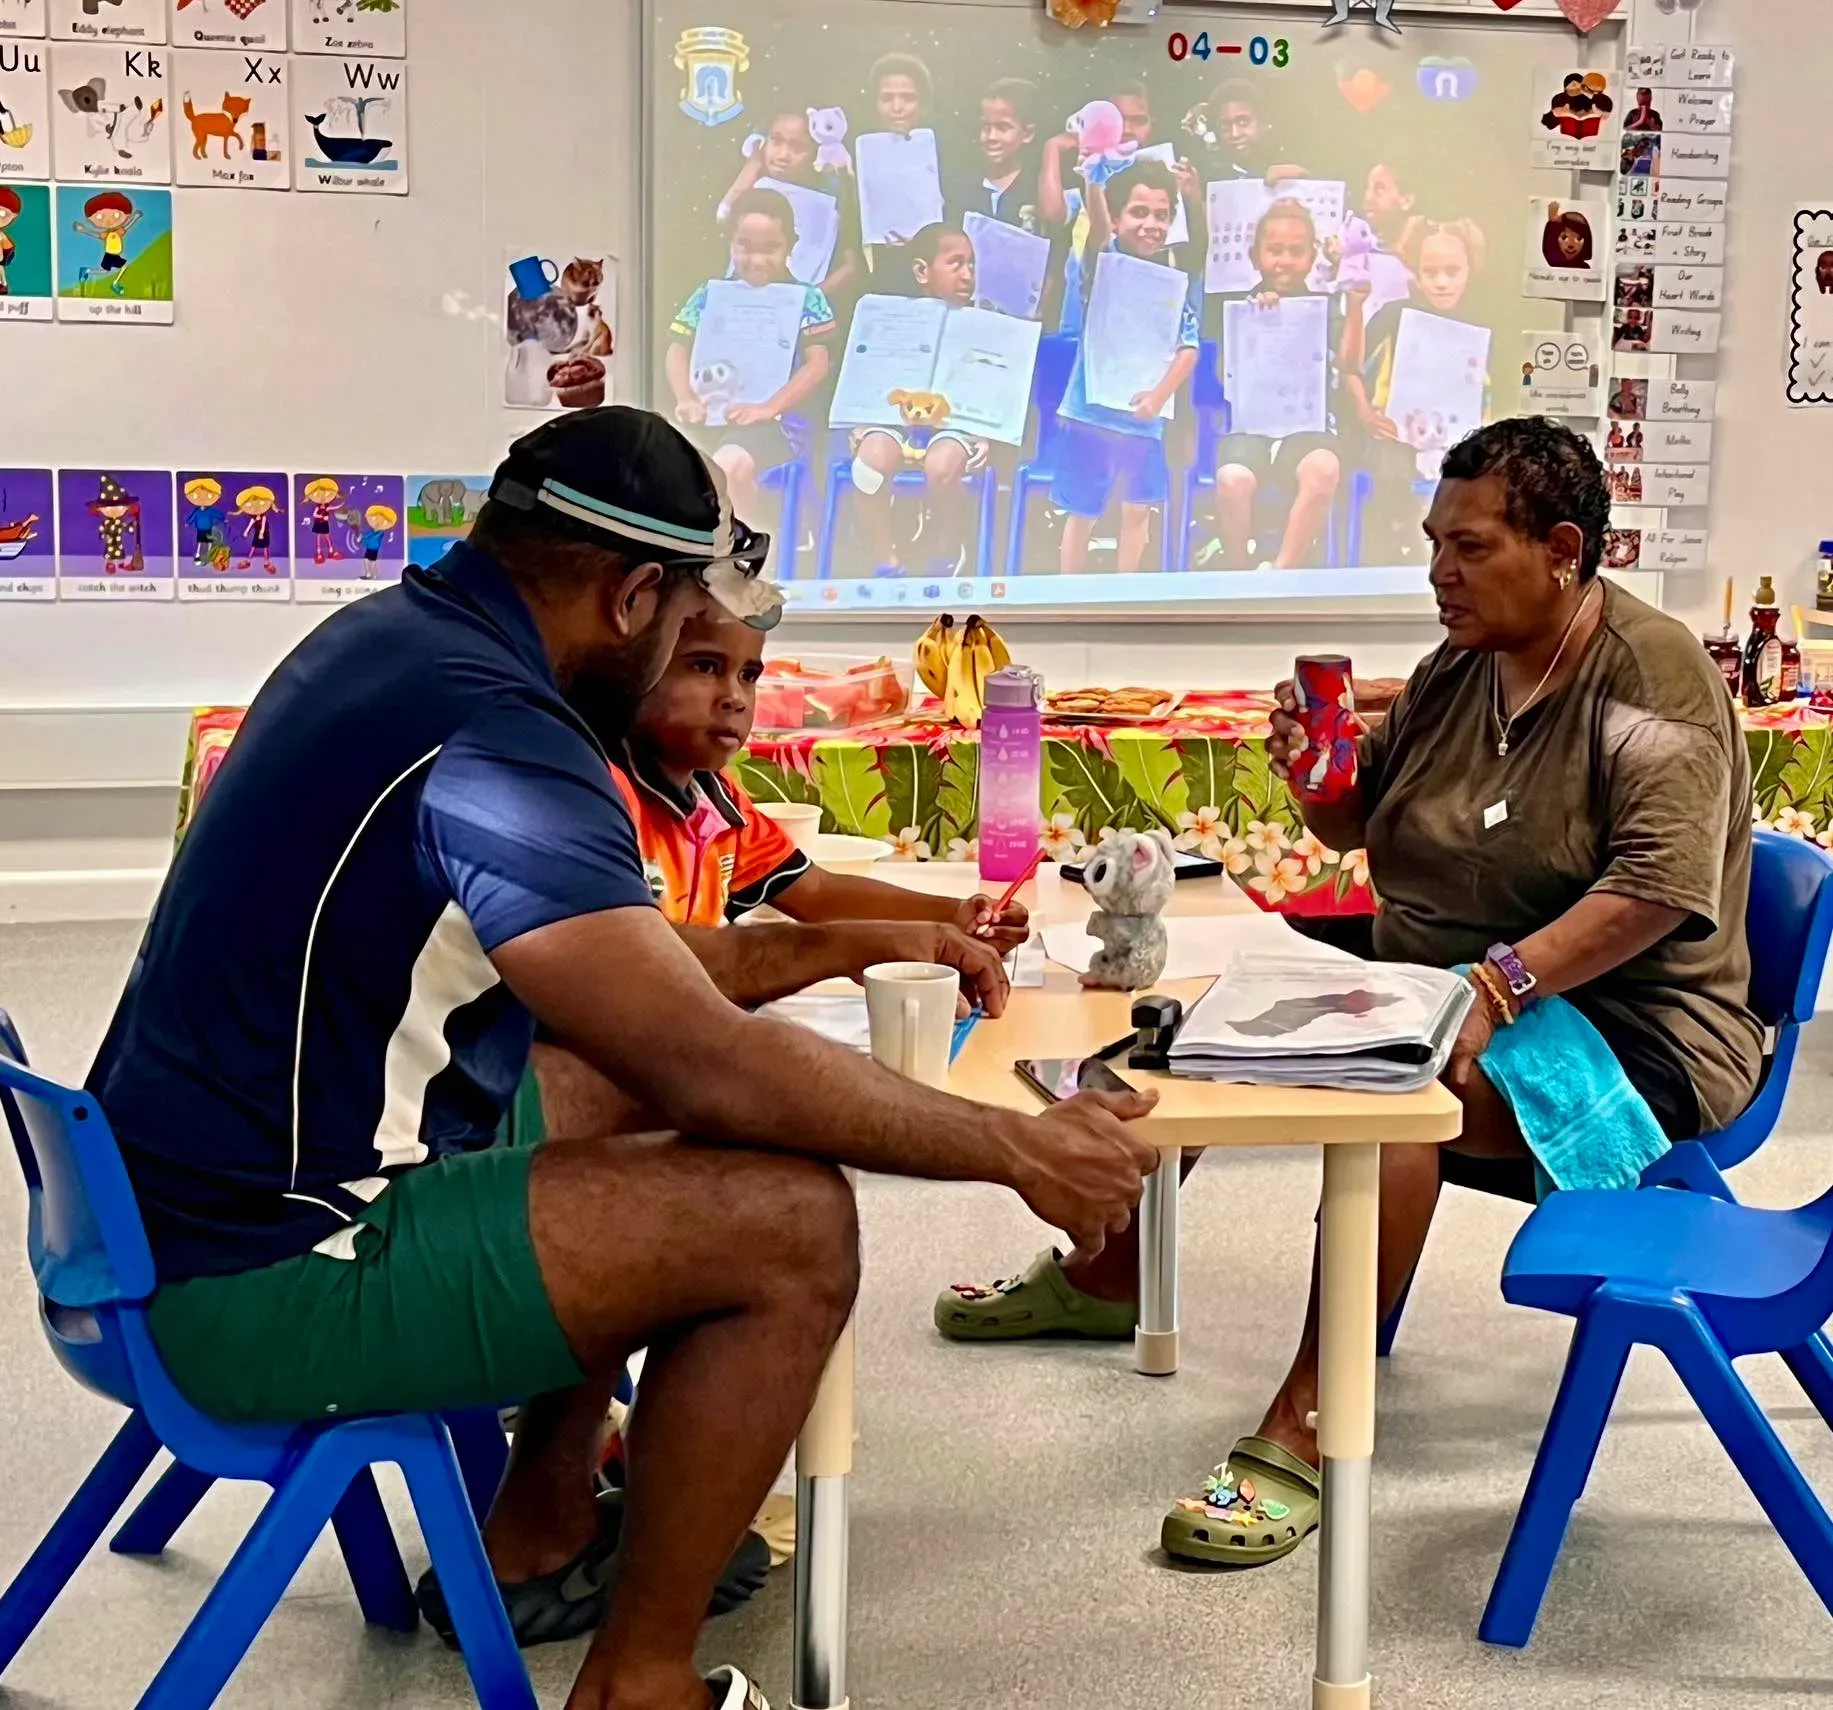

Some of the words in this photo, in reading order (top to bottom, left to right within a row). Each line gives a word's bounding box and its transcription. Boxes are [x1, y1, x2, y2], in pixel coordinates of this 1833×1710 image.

[325, 37, 343, 47] Zoe
[126, 51, 162, 78] Kk
[1691, 49, 1716, 66] Ready
[245, 57, 281, 84] Xx
[344, 62, 400, 90] Ww
[1688, 70, 1711, 81] Learn
[1678, 94, 1713, 106] Welcome
[1689, 116, 1716, 132] Prayer
[1671, 147, 1719, 165] Handwriting
[212, 170, 235, 181] Max
[1661, 193, 1692, 209] Reading
[1684, 247, 1706, 262] Story
[1677, 270, 1693, 281] Our
[1659, 290, 1684, 300] Heart
[1689, 290, 1716, 301] Words
[89, 305, 103, 315] up
[106, 303, 121, 314] the
[1671, 324, 1702, 341] Writing
[1662, 401, 1701, 418] Breathing
